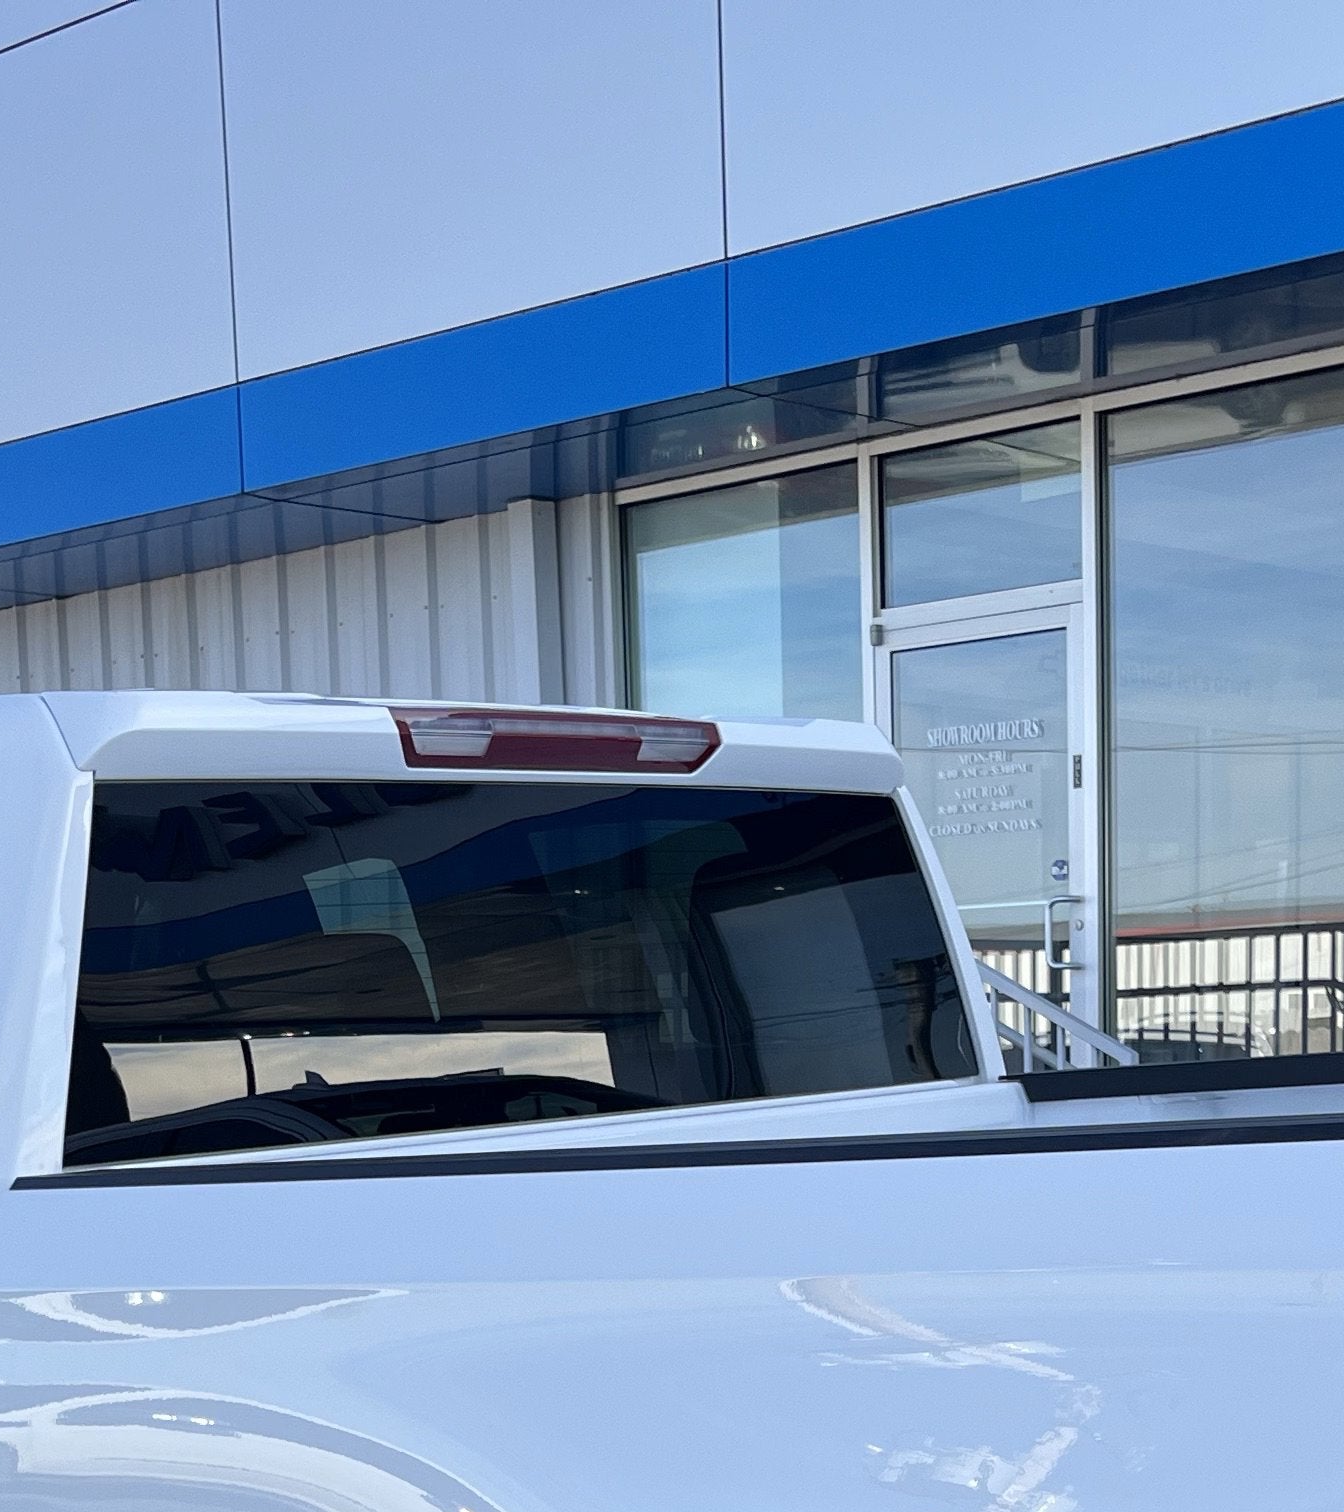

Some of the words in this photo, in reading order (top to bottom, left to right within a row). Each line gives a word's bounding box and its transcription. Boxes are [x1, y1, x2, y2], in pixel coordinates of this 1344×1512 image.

[926, 721, 995, 748] SHOWROOM
[997, 718, 1040, 741] HOURS
[954, 784, 1009, 800] SATURDAY
[929, 822, 972, 837] CLOSED
[987, 818, 1038, 834] SUNDAYS
